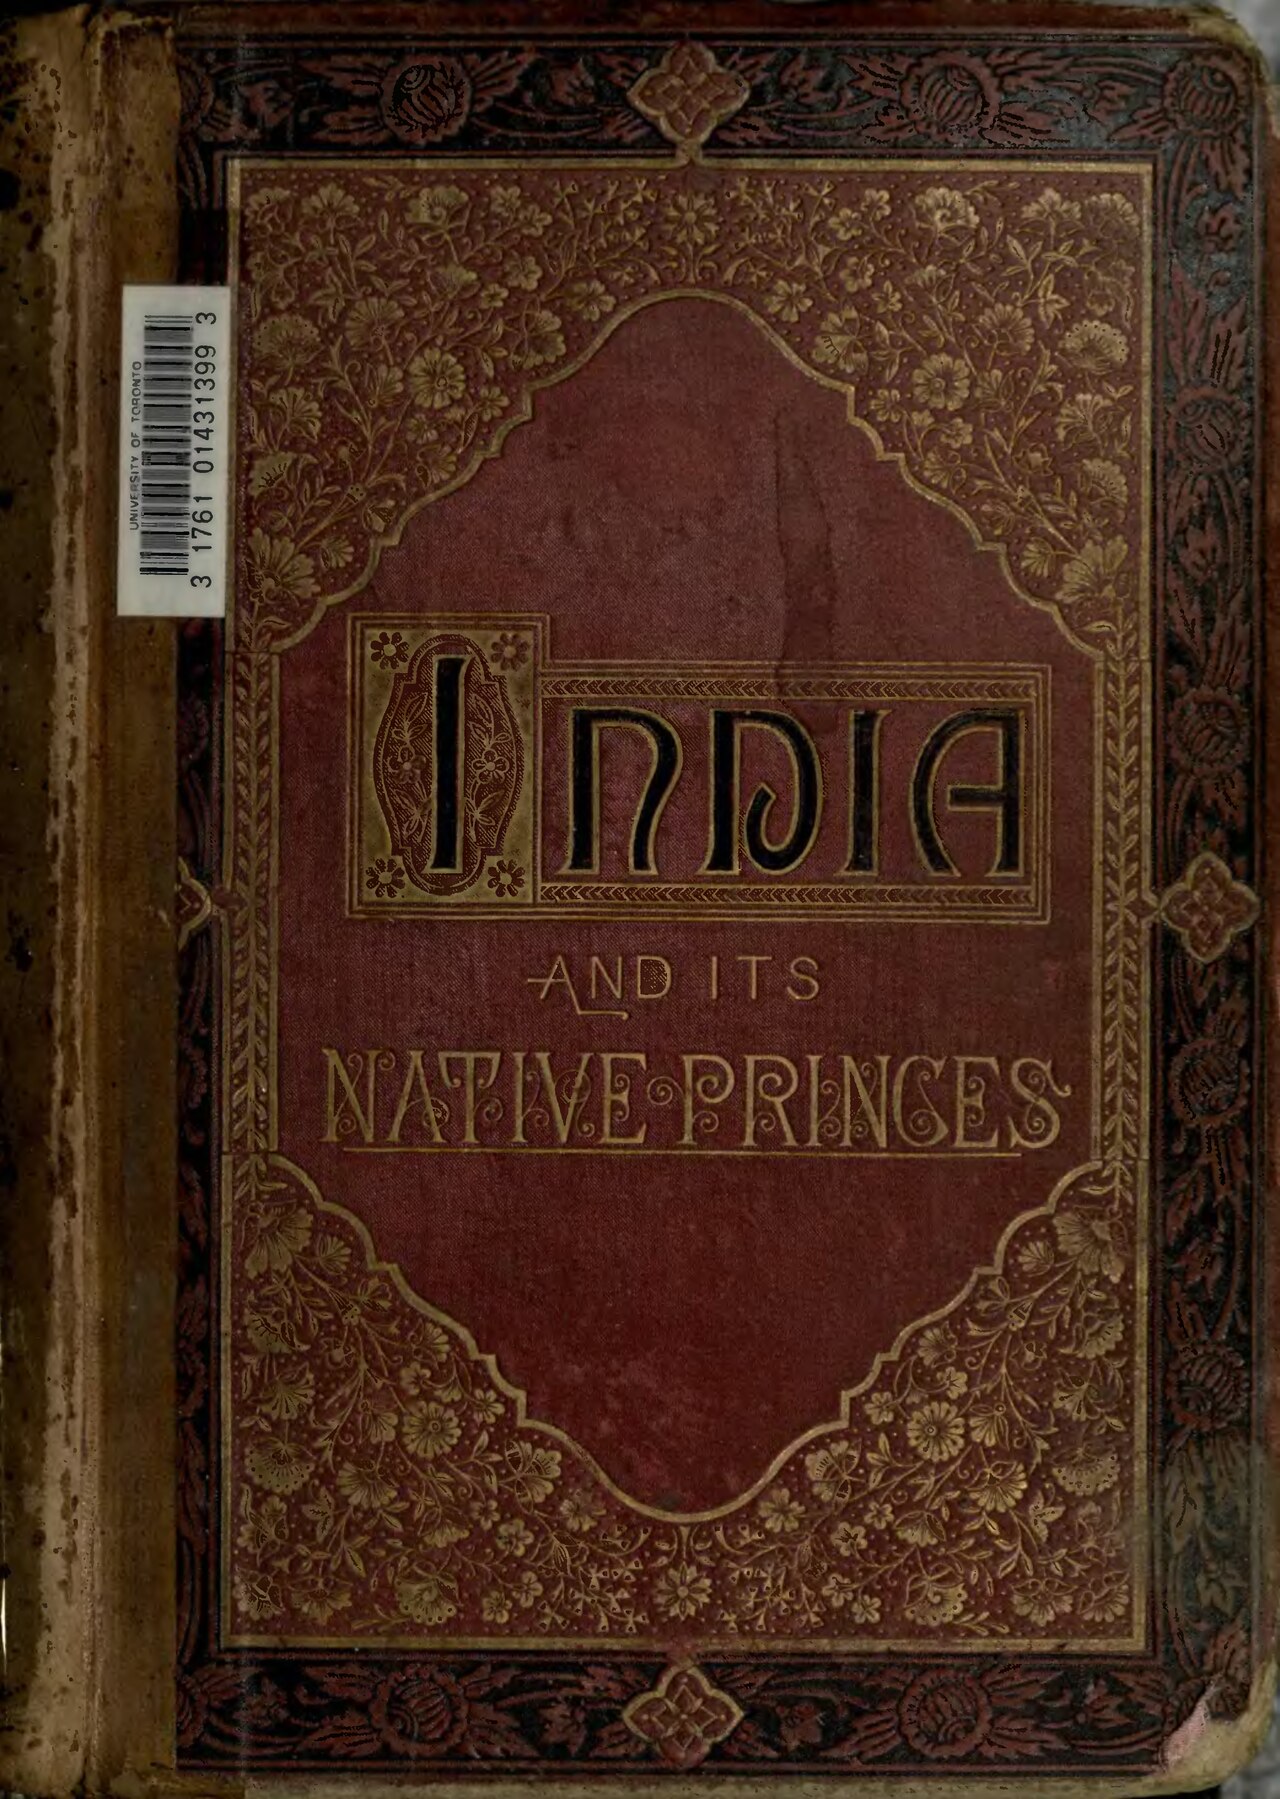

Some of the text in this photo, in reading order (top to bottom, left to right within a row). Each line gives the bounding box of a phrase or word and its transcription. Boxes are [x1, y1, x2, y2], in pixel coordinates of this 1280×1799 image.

[130, 361, 142, 531] UNIVERSITY OF TORONTO
[190, 312, 217, 588] 3 1761 01431399 3
[421, 655, 1027, 877] INDIA
[526, 955, 820, 1019] AND ITS
[319, 1047, 1072, 1150] NATIVE PRINCES
